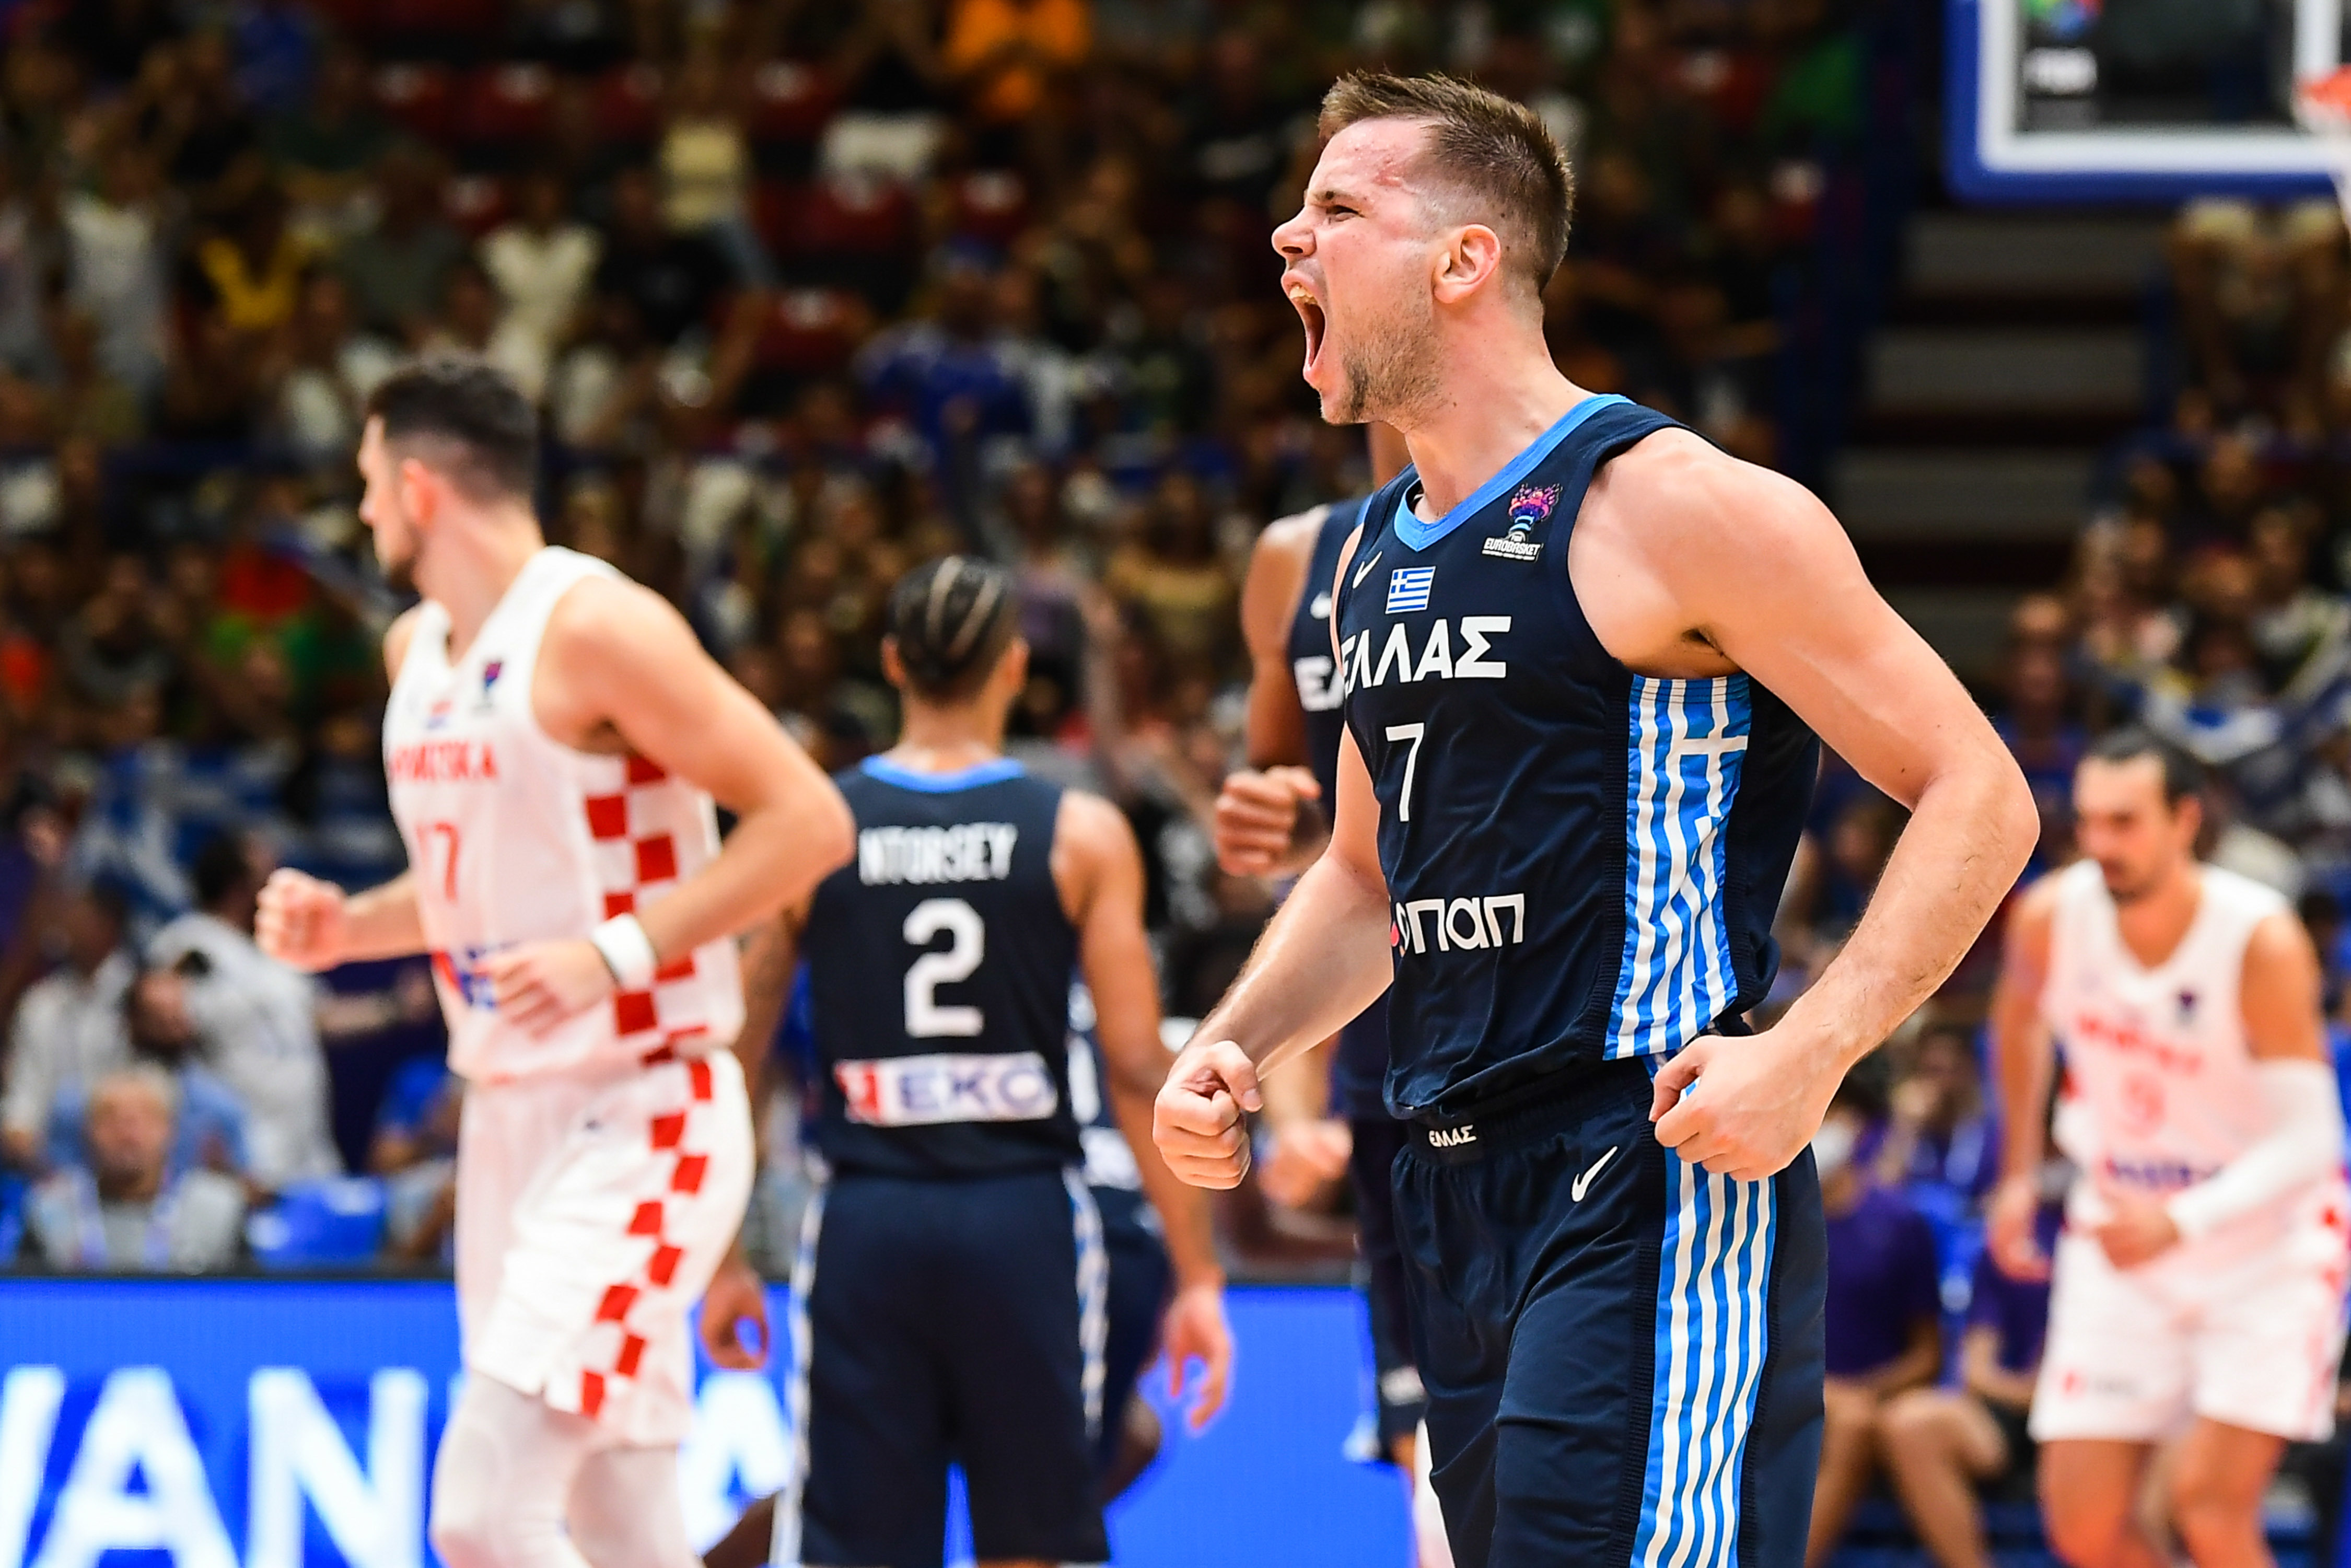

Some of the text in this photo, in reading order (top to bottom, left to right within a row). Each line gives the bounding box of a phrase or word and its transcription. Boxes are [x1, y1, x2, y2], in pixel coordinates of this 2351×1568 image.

[1483, 537, 1541, 555] EUROBASKET
[1385, 722, 1425, 822] 7
[903, 897, 985, 1038] 2
[898, 1068, 1055, 1111] EKO
